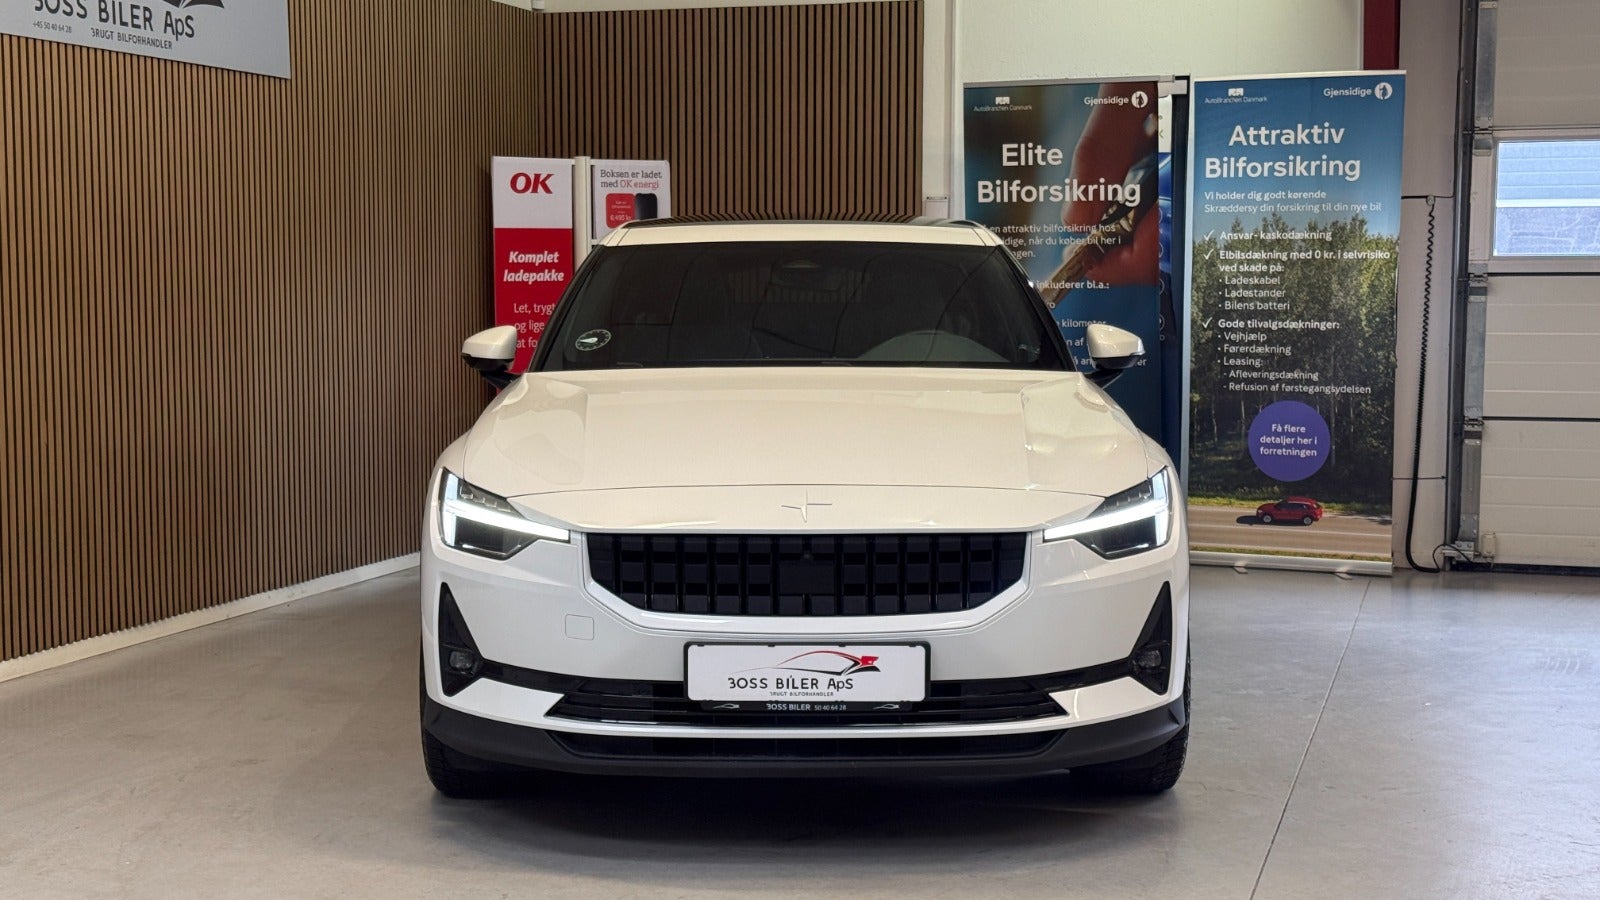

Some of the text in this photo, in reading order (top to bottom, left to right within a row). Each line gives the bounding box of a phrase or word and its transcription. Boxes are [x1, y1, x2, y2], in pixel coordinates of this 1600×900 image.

[164, 10, 195, 42] ApS
[117, 32, 173, 50] BILFORHANDLER
[1324, 88, 1372, 98] Gjensidige
[1084, 96, 1129, 105] Gjensidige
[1228, 122, 1345, 146] Attraktiv
[1002, 142, 1063, 167] Elite
[1205, 154, 1360, 182] Bilforsikring
[600, 170, 629, 178] Boksen
[510, 172, 554, 194] OK
[600, 180, 659, 190] med OK energi
[978, 178, 1141, 207] Bilforsikring
[1204, 191, 1326, 201] Vi holder dig godt kørende
[1204, 202, 1381, 213] Skræddersy din forsikring til din nye bil
[1002, 225, 1041, 233] attraktiv
[1043, 224, 1096, 234] bilforsikring
[1099, 224, 1116, 232] hos
[1029, 237, 1043, 245] når
[1045, 237, 1057, 245] du
[1059, 237, 1085, 245] køber
[1087, 237, 1098, 245] bil
[1260, 231, 1332, 241] kaskodækning
[508, 251, 559, 265] Komplet
[1220, 250, 1390, 261] Elbilsdækning med 0 kr. i selvrisiko
[1220, 263, 1284, 273] ved skade på:
[503, 270, 564, 284] ladepakke
[1225, 276, 1280, 285] Ladeskabel
[1036, 280, 1110, 289] inkluderer bl.a.:
[1225, 289, 1286, 297] Ladestander
[514, 303, 531, 314] Let,
[1225, 301, 1290, 310] Bilens batteri
[515, 322, 526, 333] og
[1218, 319, 1340, 330] Gode tilvalgsdækninger:
[1224, 332, 1267, 342] Vejhjælp
[1224, 344, 1291, 355] Førerdækning
[1224, 357, 1263, 367] Leasing:
[1229, 371, 1319, 381] Afleveringsdækning
[1229, 383, 1372, 394] Refusion af førstegangsydelsen
[1272, 424, 1305, 433] Få flere
[1260, 436, 1317, 446] detaljer her i
[1260, 447, 1317, 457] forretningen
[827, 678, 853, 692] ApS
